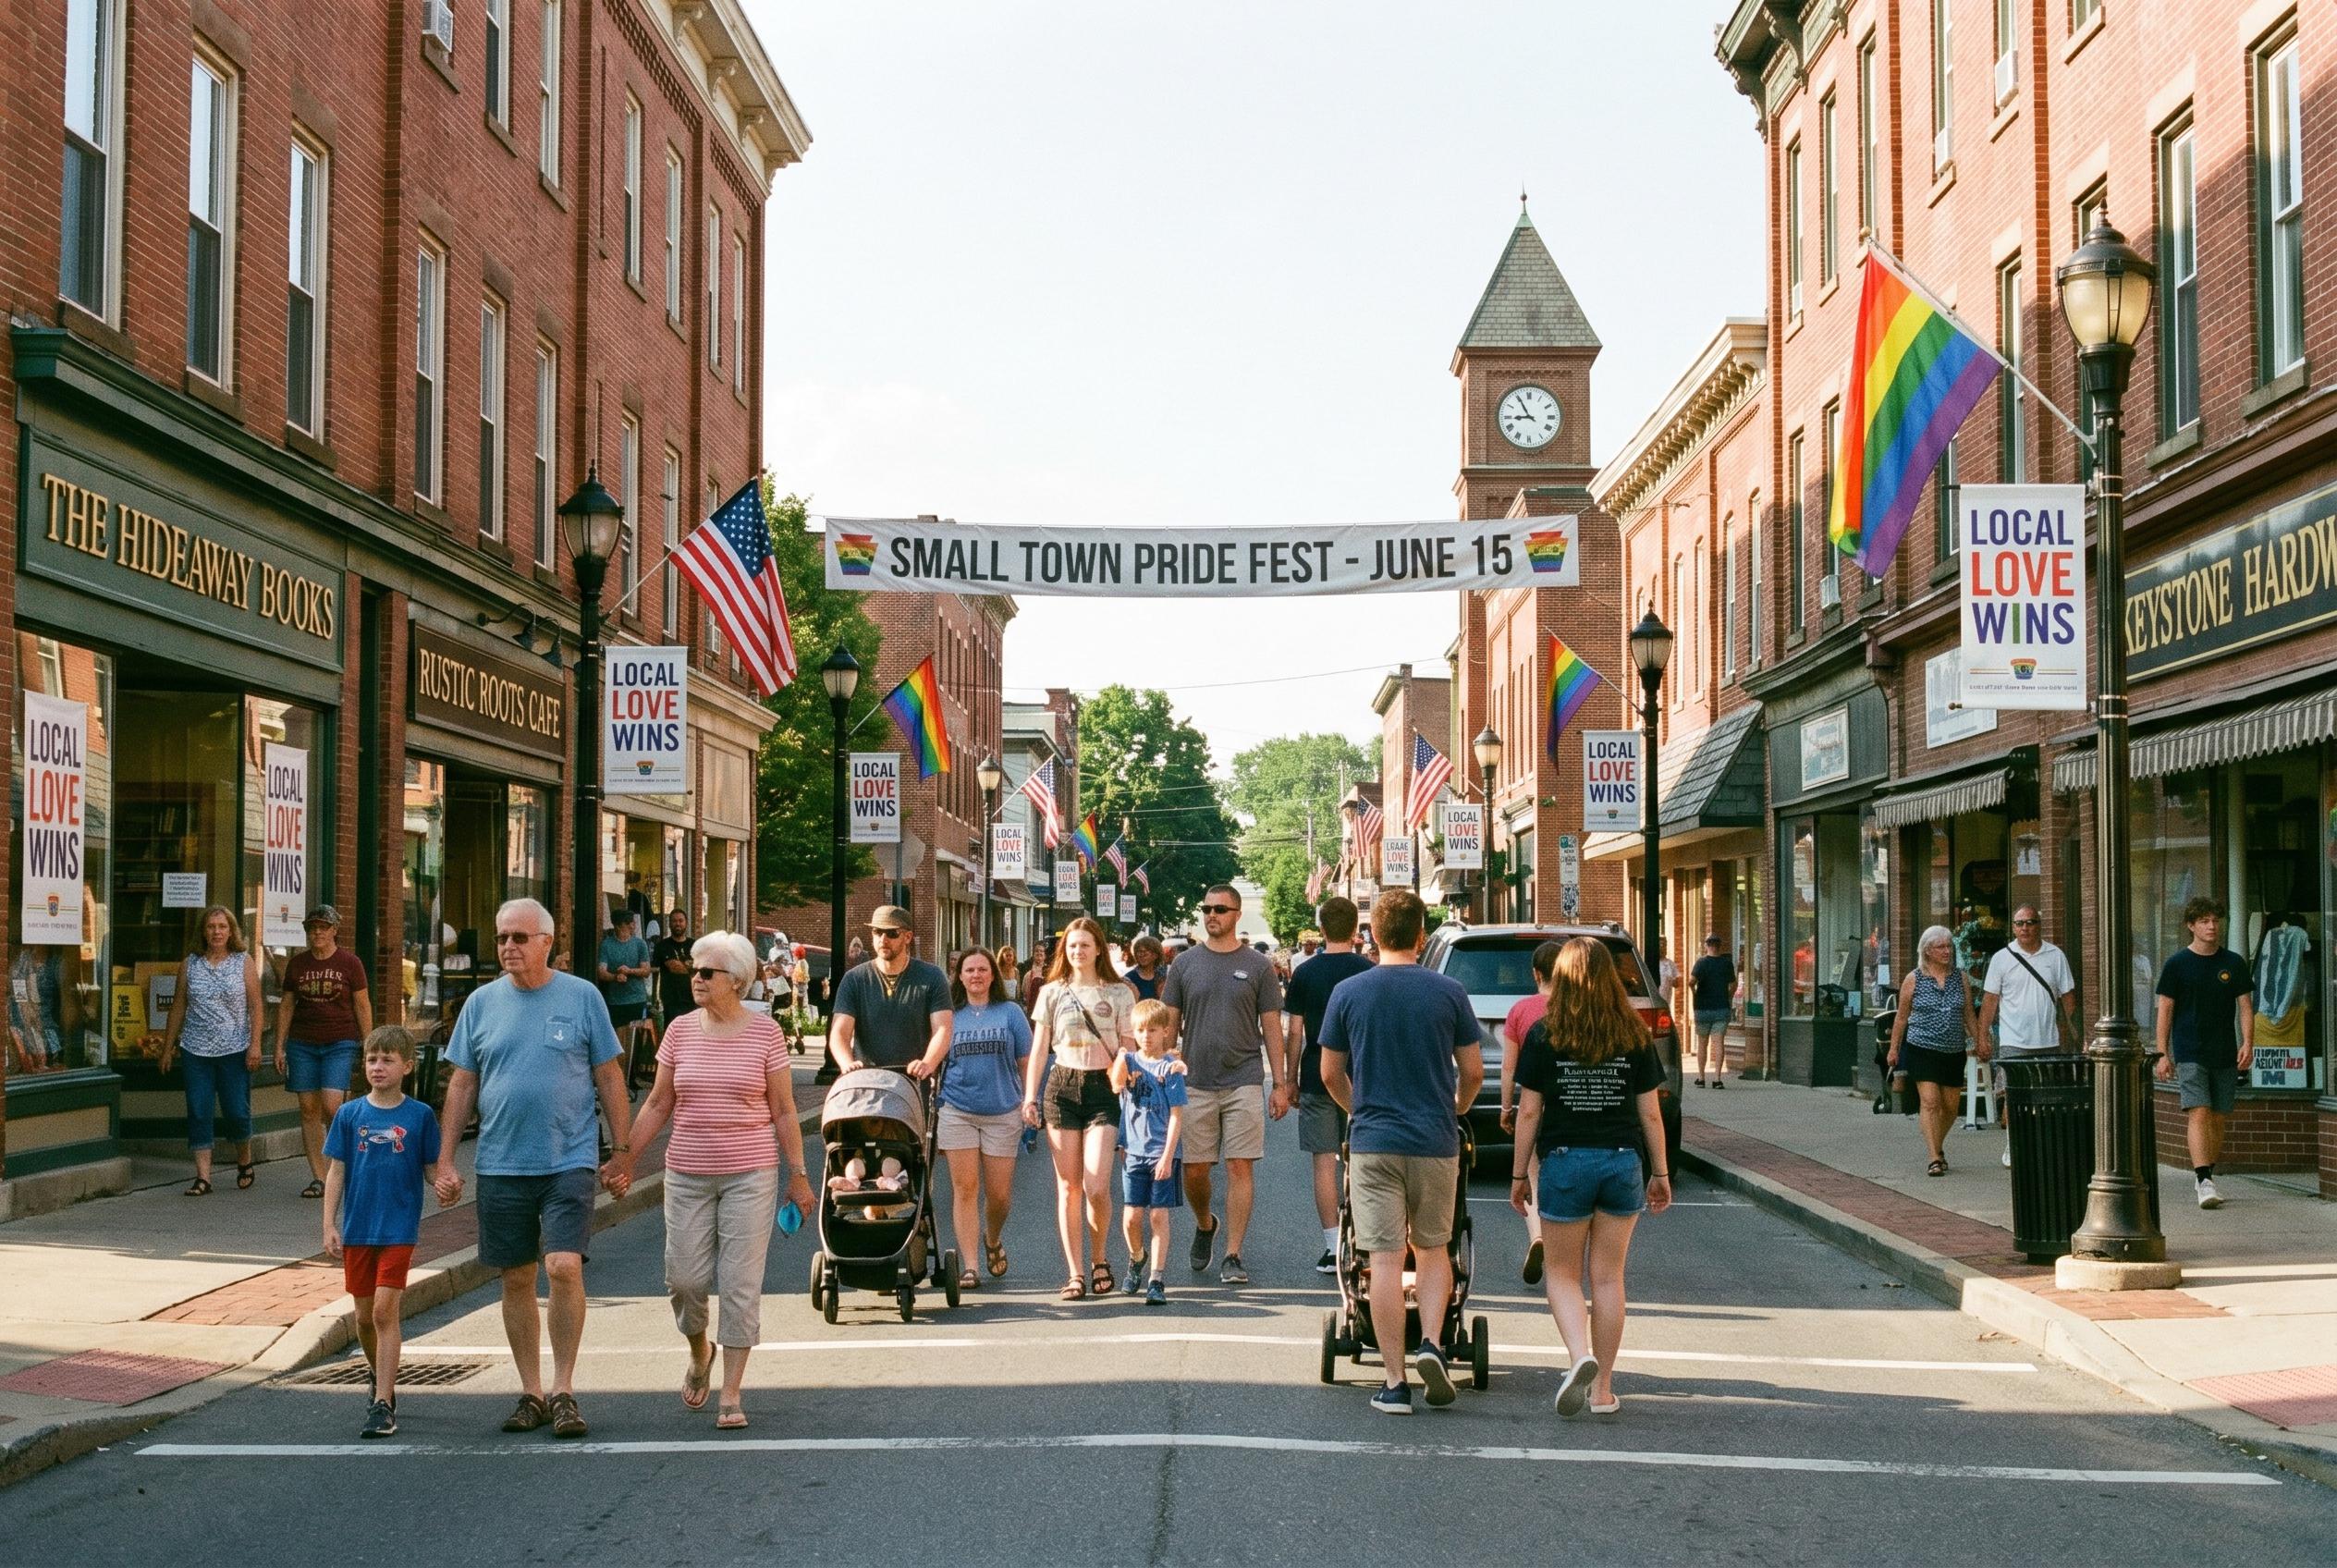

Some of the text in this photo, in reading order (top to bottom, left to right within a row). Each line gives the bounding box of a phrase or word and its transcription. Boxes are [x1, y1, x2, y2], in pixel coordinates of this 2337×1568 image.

[1971, 509, 2074, 545] LOCAL
[43, 472, 334, 640] THE HIDEAWAY BOOKS
[890, 536, 1009, 582] SMALL
[1019, 541, 1121, 584] TOWN
[1134, 543, 1237, 584] PRIDE
[1250, 541, 1333, 583] FEST
[1370, 536, 1456, 581] JUNE
[1471, 533, 1512, 576] 15
[1972, 551, 2074, 596] LOVE
[1972, 603, 2074, 644] WINS
[613, 663, 679, 686] LOCAL
[420, 648, 560, 738] RUSTIC ROOTS CAFE
[612, 690, 679, 719] LOVE
[30, 719, 80, 768] LOCAL
[612, 724, 679, 751] WINS
[1588, 741, 1635, 758] LOCAL
[854, 763, 896, 778] LOCAL
[1588, 761, 1635, 781] LOVE
[268, 765, 302, 802] LOCAL
[854, 779, 895, 798] LOVE
[1589, 784, 1635, 802] WINS
[29, 768, 80, 826] LOVE
[854, 800, 896, 817] WINS
[267, 804, 302, 851] LOVE
[1448, 812, 1478, 822] LOCAL
[996, 828, 1022, 838] LOCAL
[1448, 824, 1478, 836] LOVE
[29, 828, 79, 880] WINS
[996, 839, 1022, 851] LOVE
[1449, 838, 1478, 850] WINS
[997, 851, 1022, 863] WINS
[1387, 851, 1408, 862] LOVE
[1387, 863, 1409, 872] WINS
[267, 852, 301, 894] WINS
